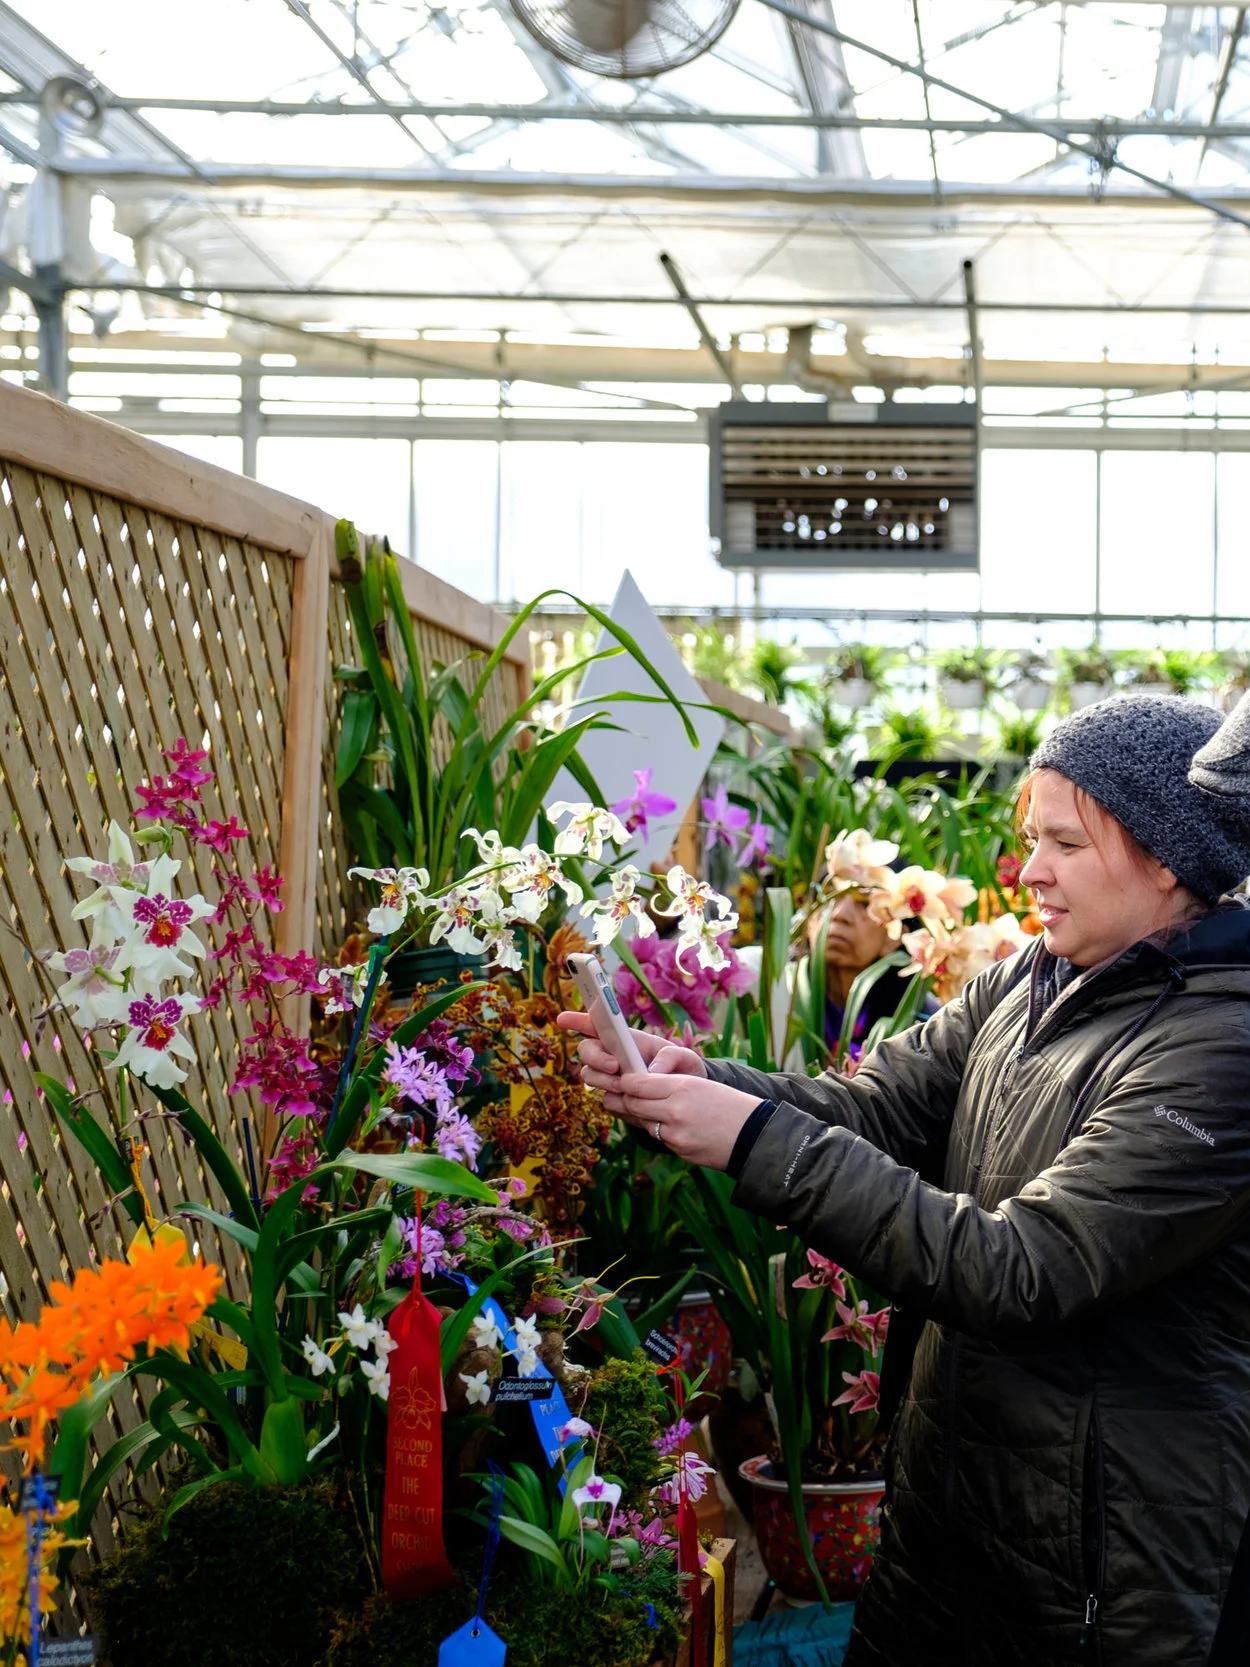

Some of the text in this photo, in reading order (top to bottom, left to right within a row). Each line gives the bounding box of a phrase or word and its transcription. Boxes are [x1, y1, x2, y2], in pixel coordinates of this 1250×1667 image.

[1166, 1110, 1216, 1147] Columbia
[783, 1135, 811, 1187] OMNI-HEAT
[393, 1438, 433, 1453] SECOND
[395, 1451, 429, 1468] PLACE
[402, 1476, 420, 1495] THE
[387, 1503, 436, 1525] DEEP CUT
[391, 1532, 432, 1551] ORCHID
